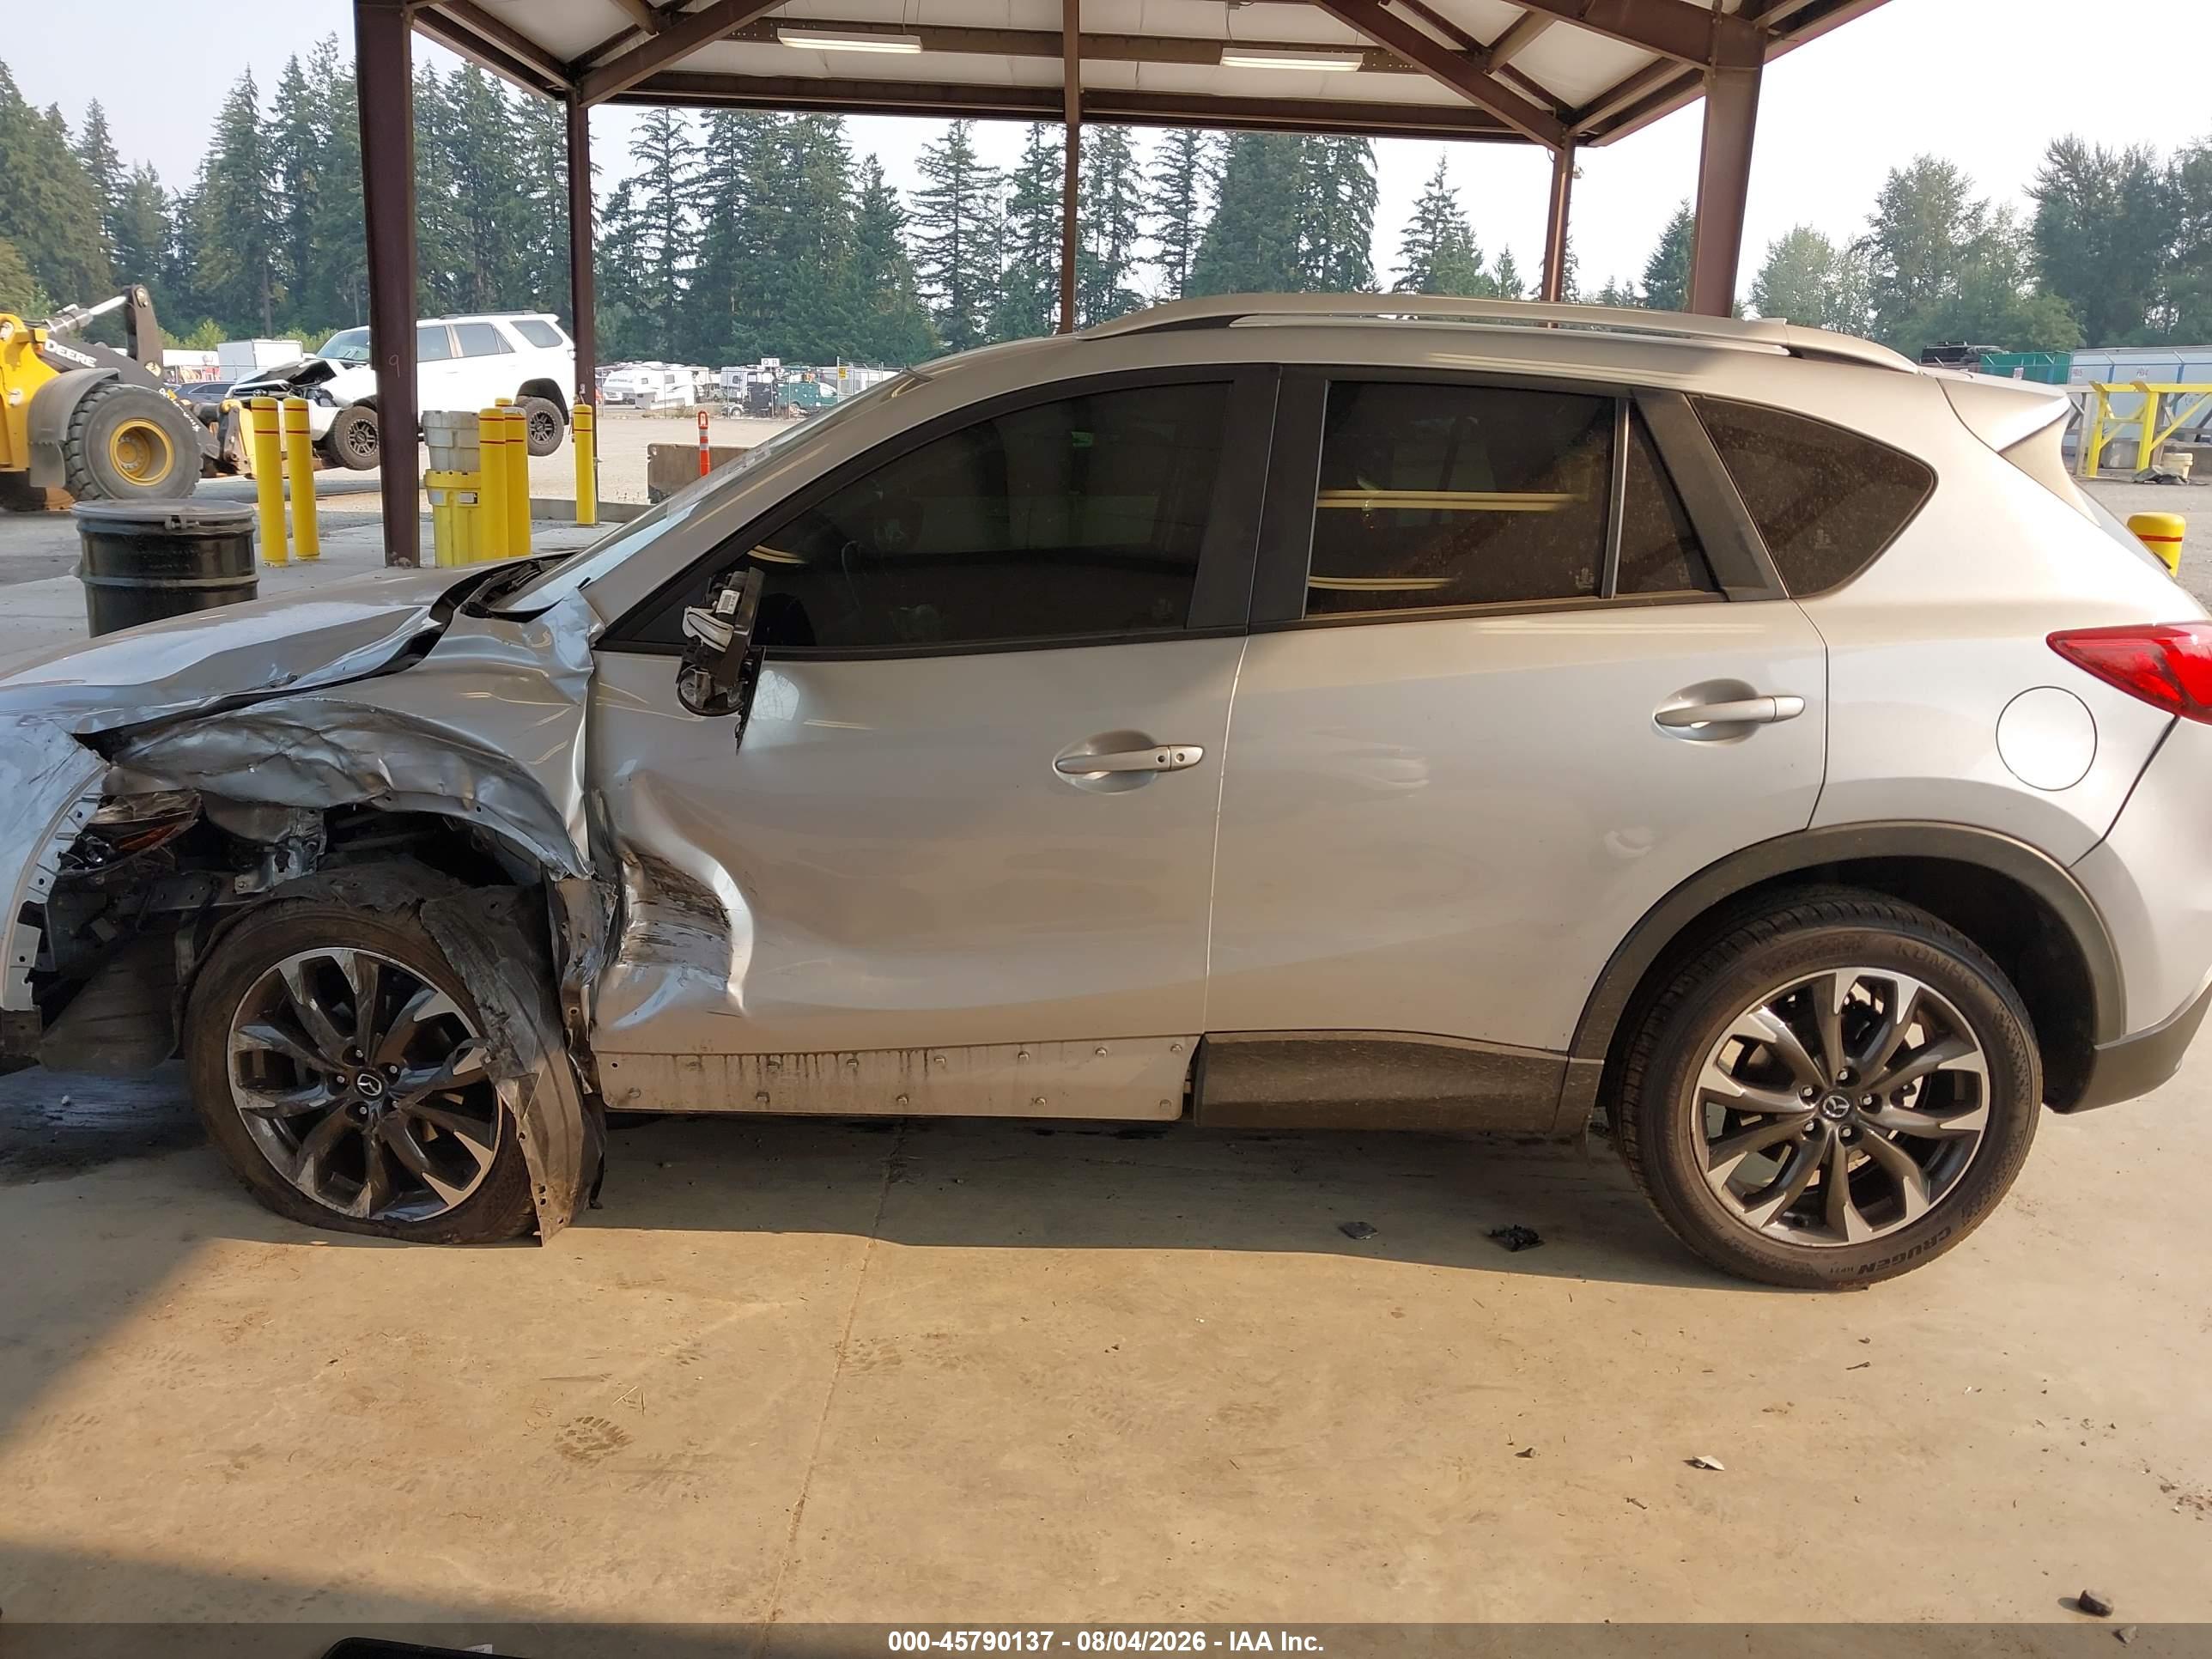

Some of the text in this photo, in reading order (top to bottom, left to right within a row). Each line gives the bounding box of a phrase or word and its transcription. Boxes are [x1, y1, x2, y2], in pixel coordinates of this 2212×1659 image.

[45, 338, 97, 368] DEERE
[388, 354, 400, 379] 9
[1894, 942, 1979, 991] KUMHO
